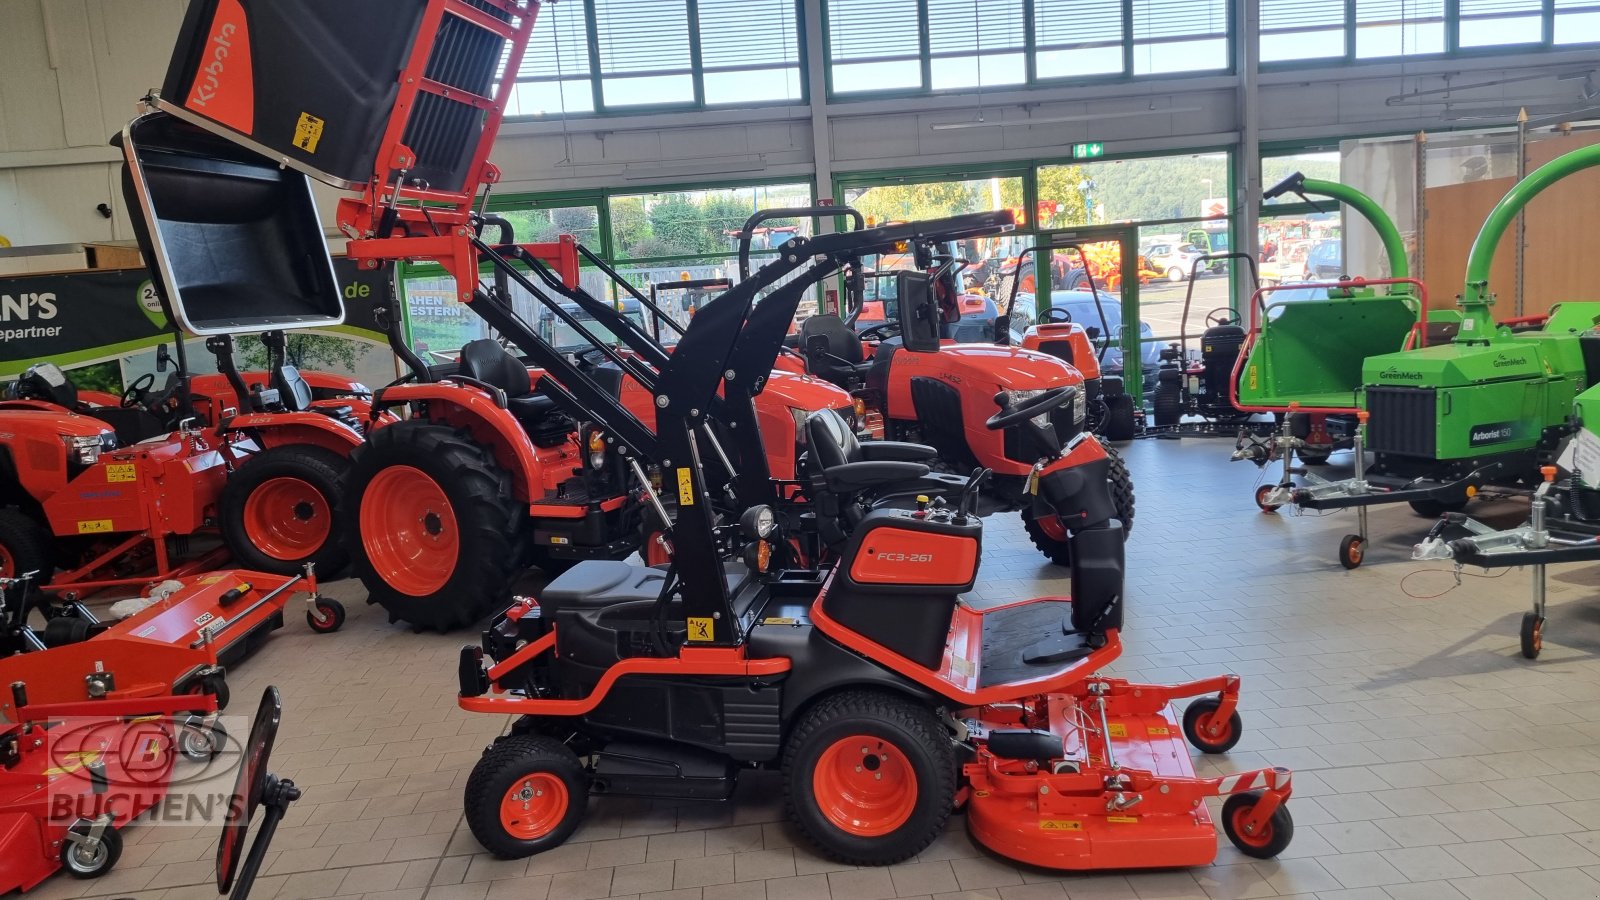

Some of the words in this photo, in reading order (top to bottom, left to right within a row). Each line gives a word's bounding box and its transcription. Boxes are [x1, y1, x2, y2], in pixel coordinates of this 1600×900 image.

[192, 23, 236, 106] Kubota
[0, 292, 58, 321] N'S
[147, 300, 161, 308] onli
[1493, 357, 1527, 368] GreenMech
[1380, 371, 1423, 380] GreenMech
[1473, 430, 1500, 440] Arborist
[877, 552, 933, 562] FC3-261
